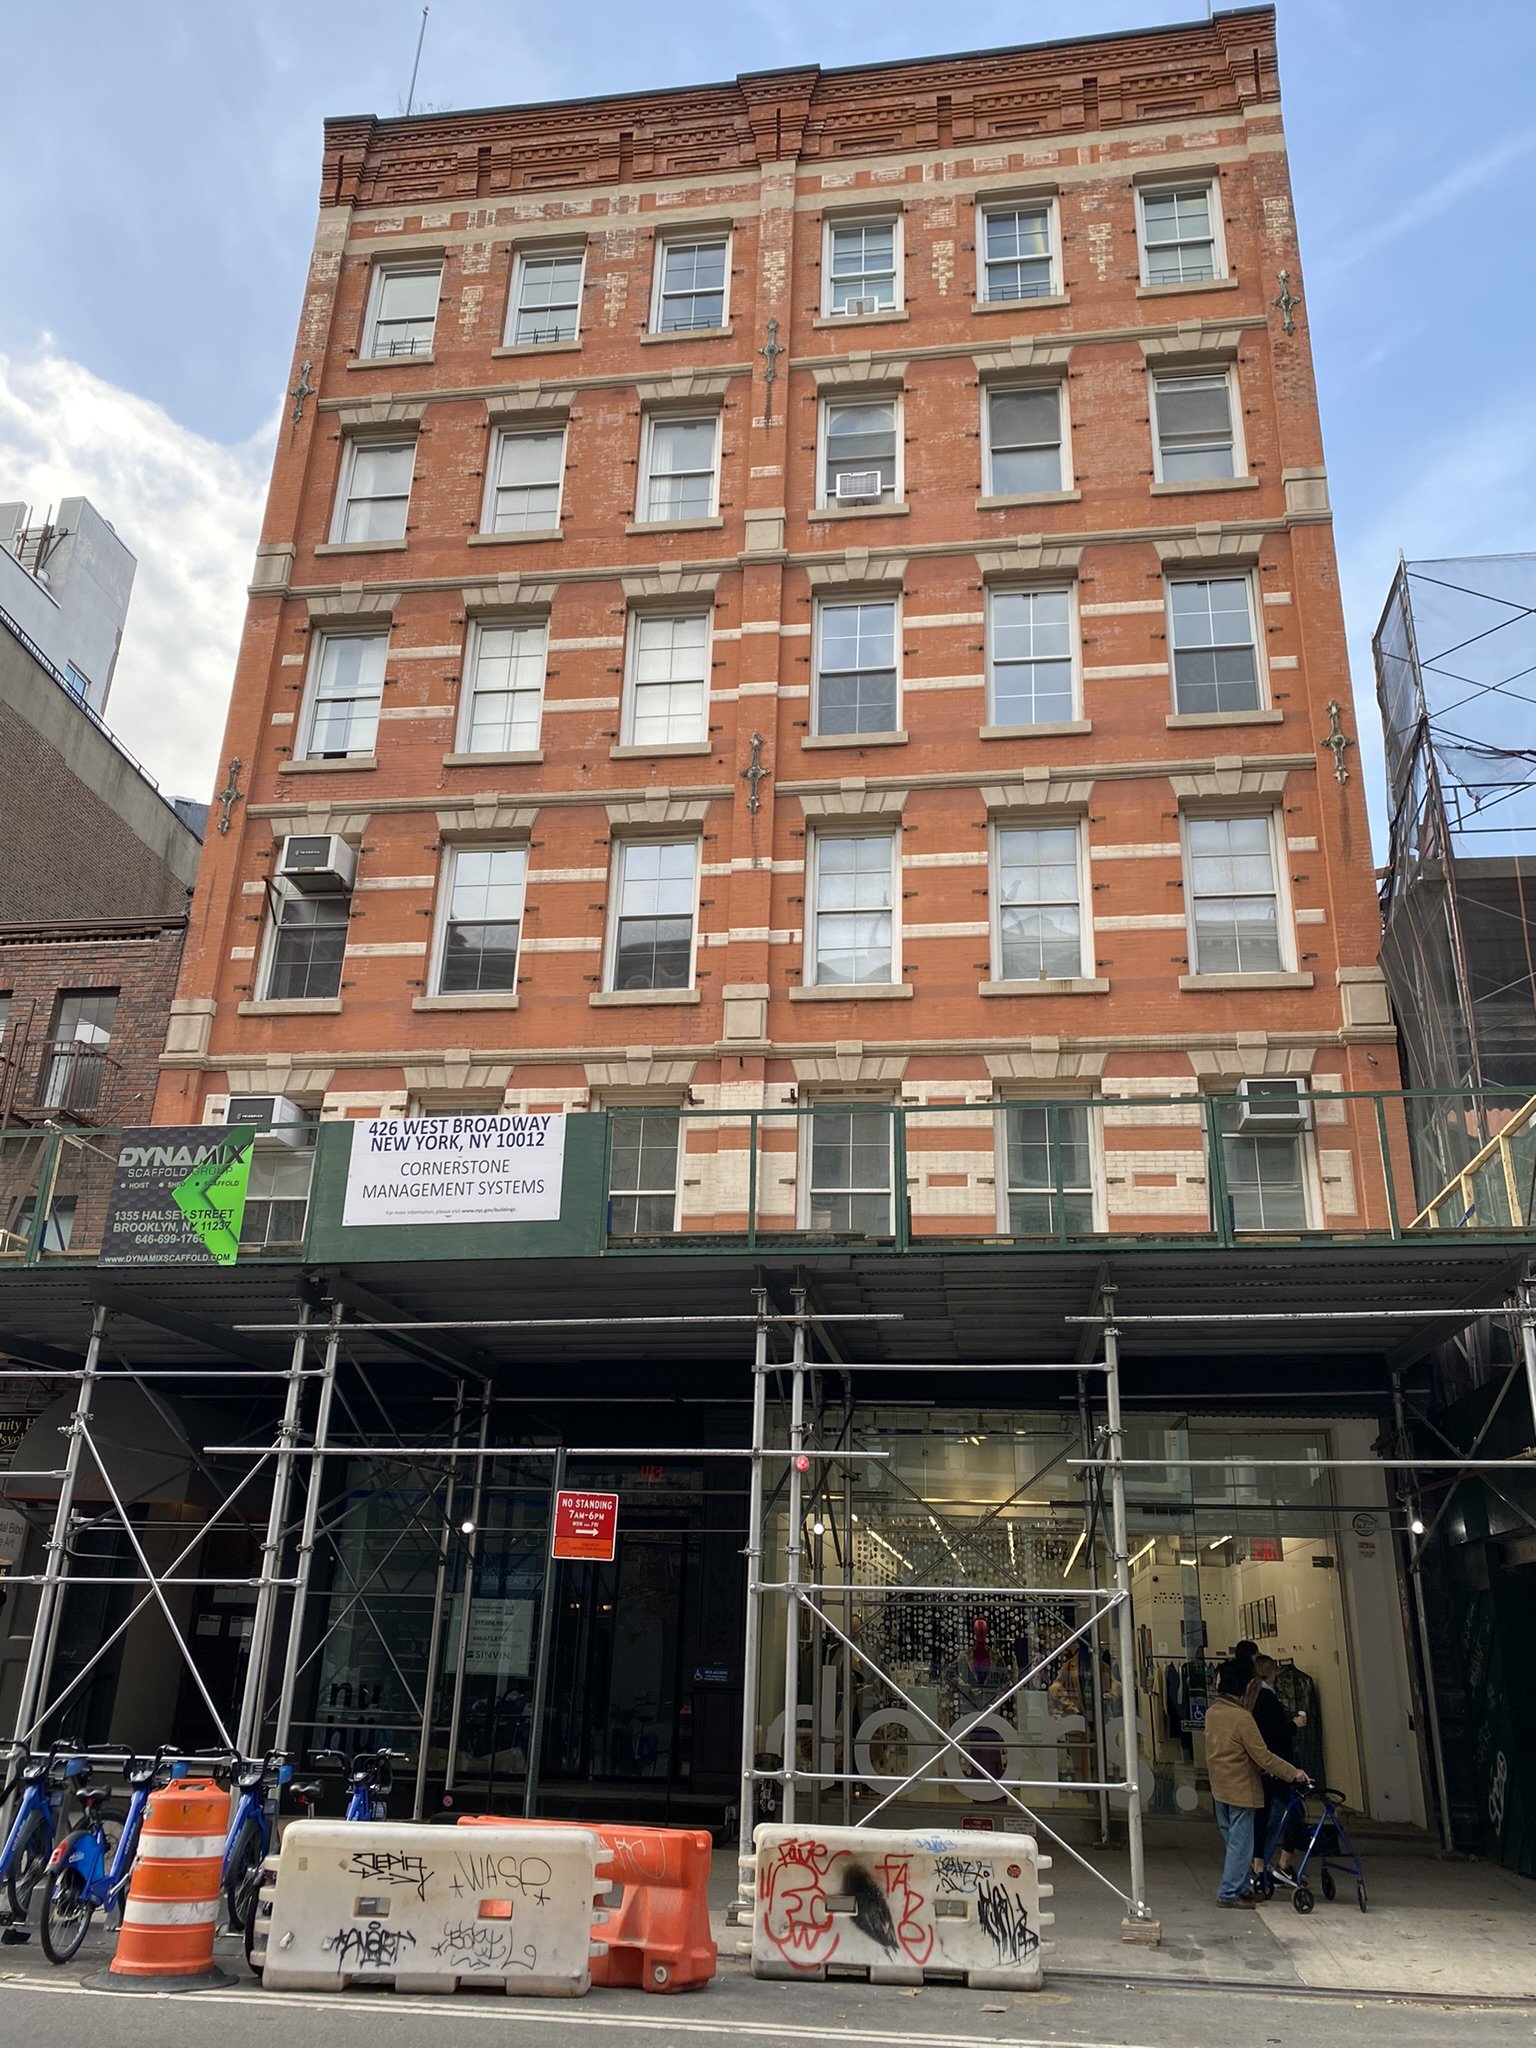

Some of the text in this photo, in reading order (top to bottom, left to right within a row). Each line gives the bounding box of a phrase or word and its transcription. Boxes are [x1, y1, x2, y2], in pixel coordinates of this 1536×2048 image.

[368, 1116, 551, 1136] 426 WEST BROADWAY
[370, 1131, 545, 1152] NEW YORK, NY 10012
[118, 1145, 249, 1168] DYNAMIX
[127, 1166, 234, 1178] SCAFFOLD GROUP
[400, 1159, 511, 1177] CORNERSTONE
[362, 1179, 545, 1199] MANAGEMENT SYSTEMS
[114, 1209, 235, 1221] 1355 HALSEY STREET
[112, 1221, 232, 1234] BROOKLYN, NY 11237
[104, 1253, 231, 1264] www.DYNAMIXSCAFFOLD.COM
[562, 1498, 613, 1510] NO STANDING
[568, 1509, 605, 1521] 7AM-6PM
[475, 1650, 511, 1660] SINVIN
